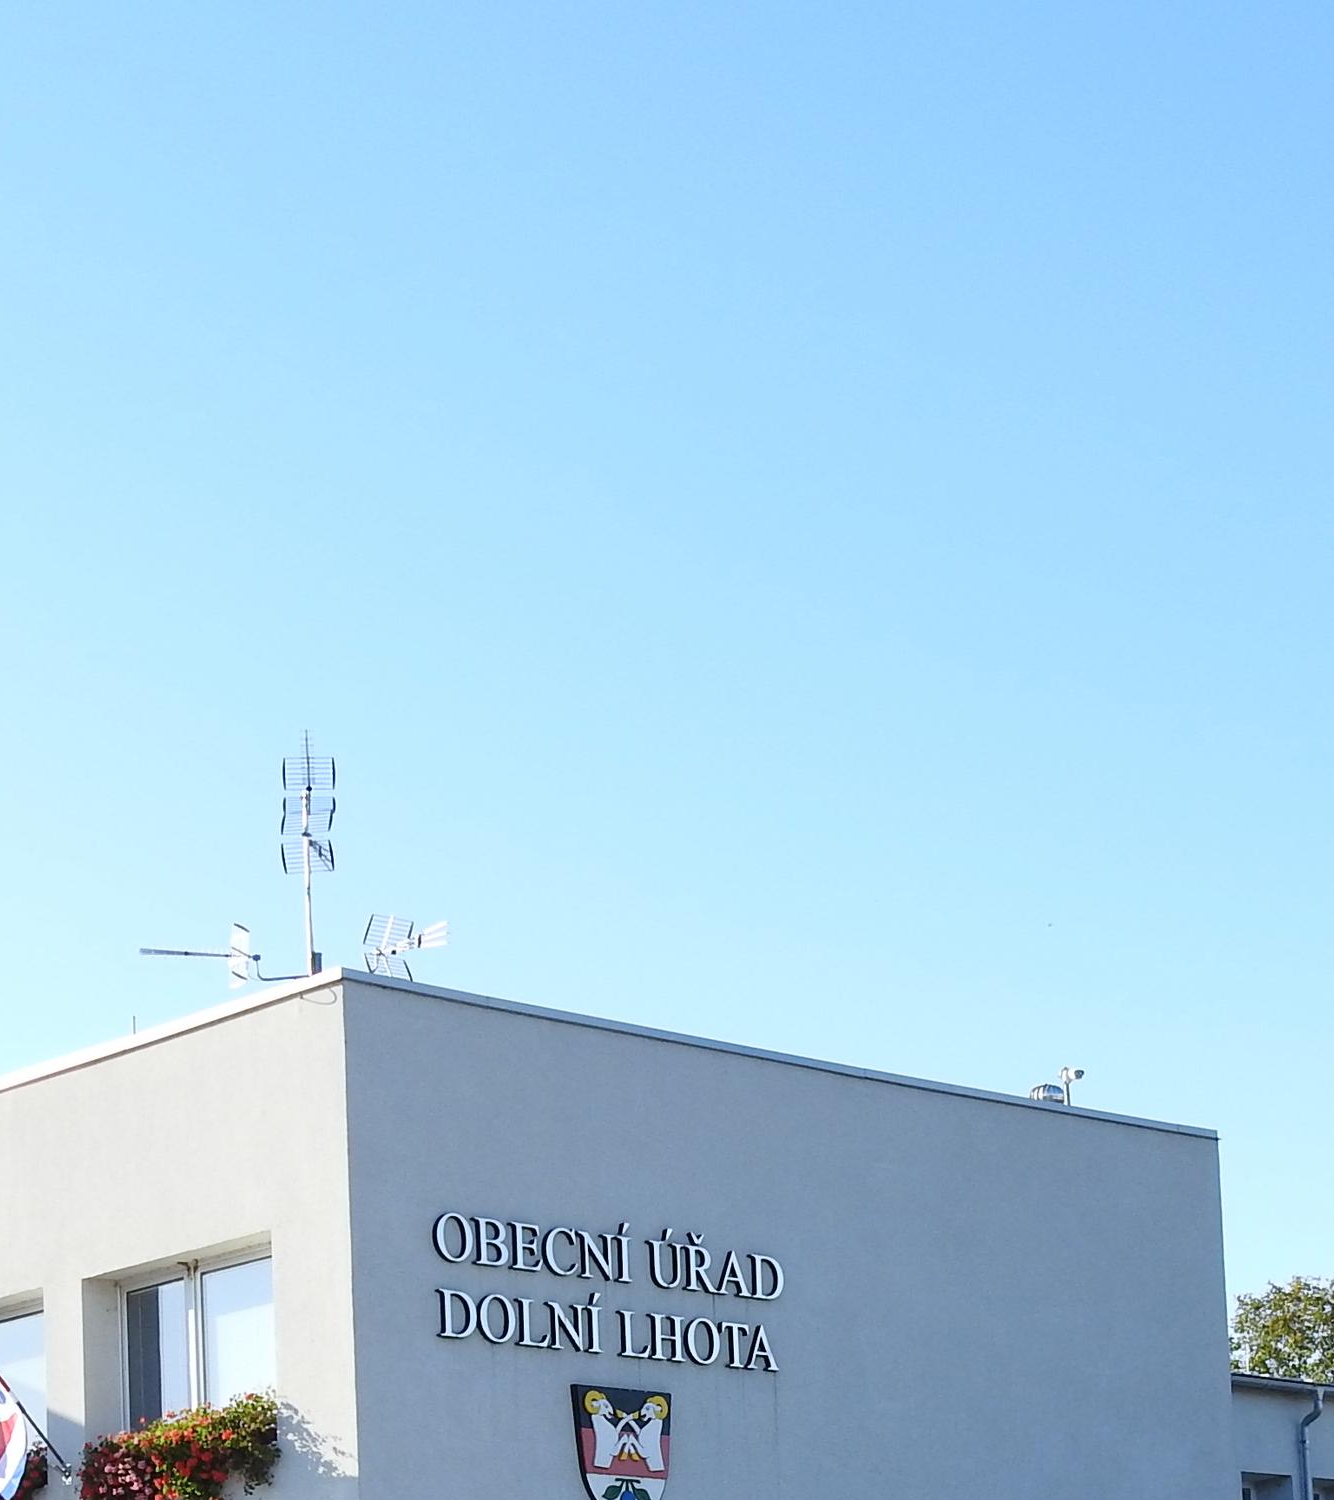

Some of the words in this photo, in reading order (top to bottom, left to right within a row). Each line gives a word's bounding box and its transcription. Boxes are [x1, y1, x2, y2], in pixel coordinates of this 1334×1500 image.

[432, 1212, 633, 1283] OBECNÍ
[645, 1228, 785, 1301] ÚŘAD
[436, 1288, 604, 1354] DOLNÍ
[616, 1310, 780, 1372] LHOTA
